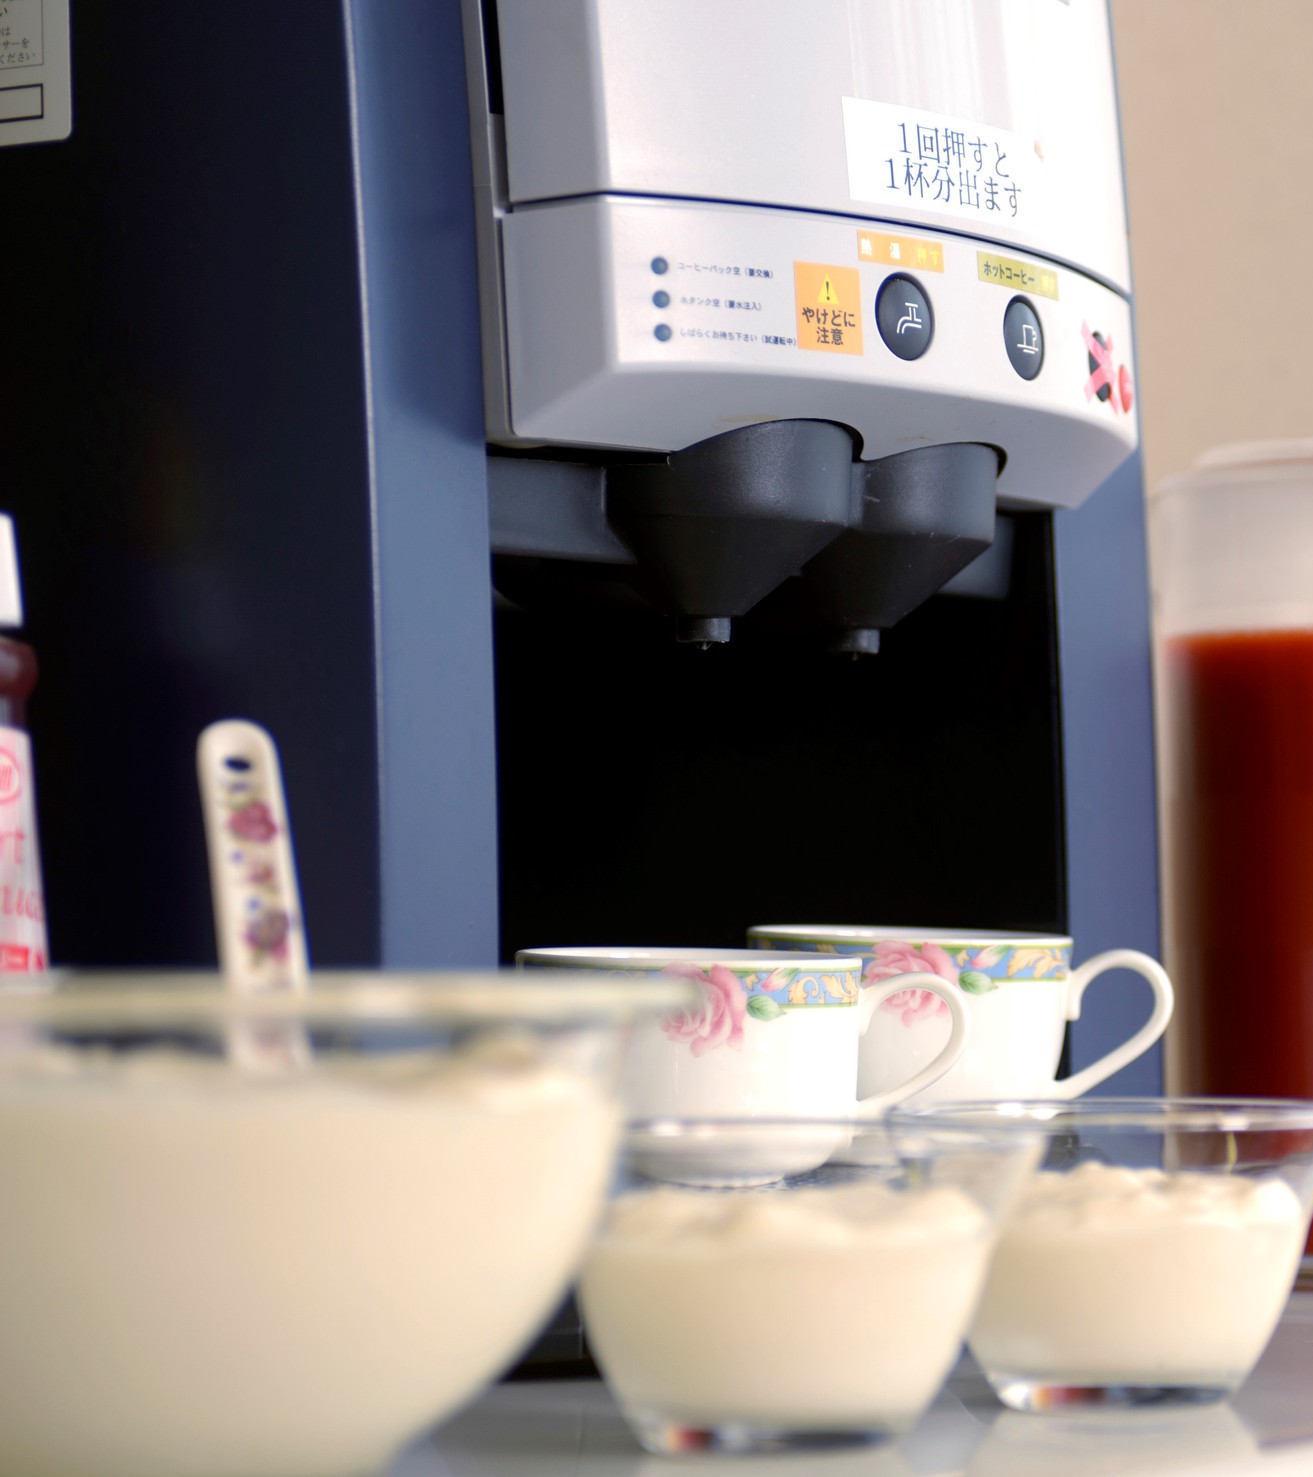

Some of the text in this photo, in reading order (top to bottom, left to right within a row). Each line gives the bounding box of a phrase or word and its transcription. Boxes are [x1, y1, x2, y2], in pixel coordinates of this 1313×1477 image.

[897, 122, 1010, 178] 1回押すと
[884, 157, 1022, 218] 1杯分出ます
[983, 261, 1035, 285] ホットコーヒー
[802, 306, 857, 328] やけどに
[816, 327, 844, 346] 注意
